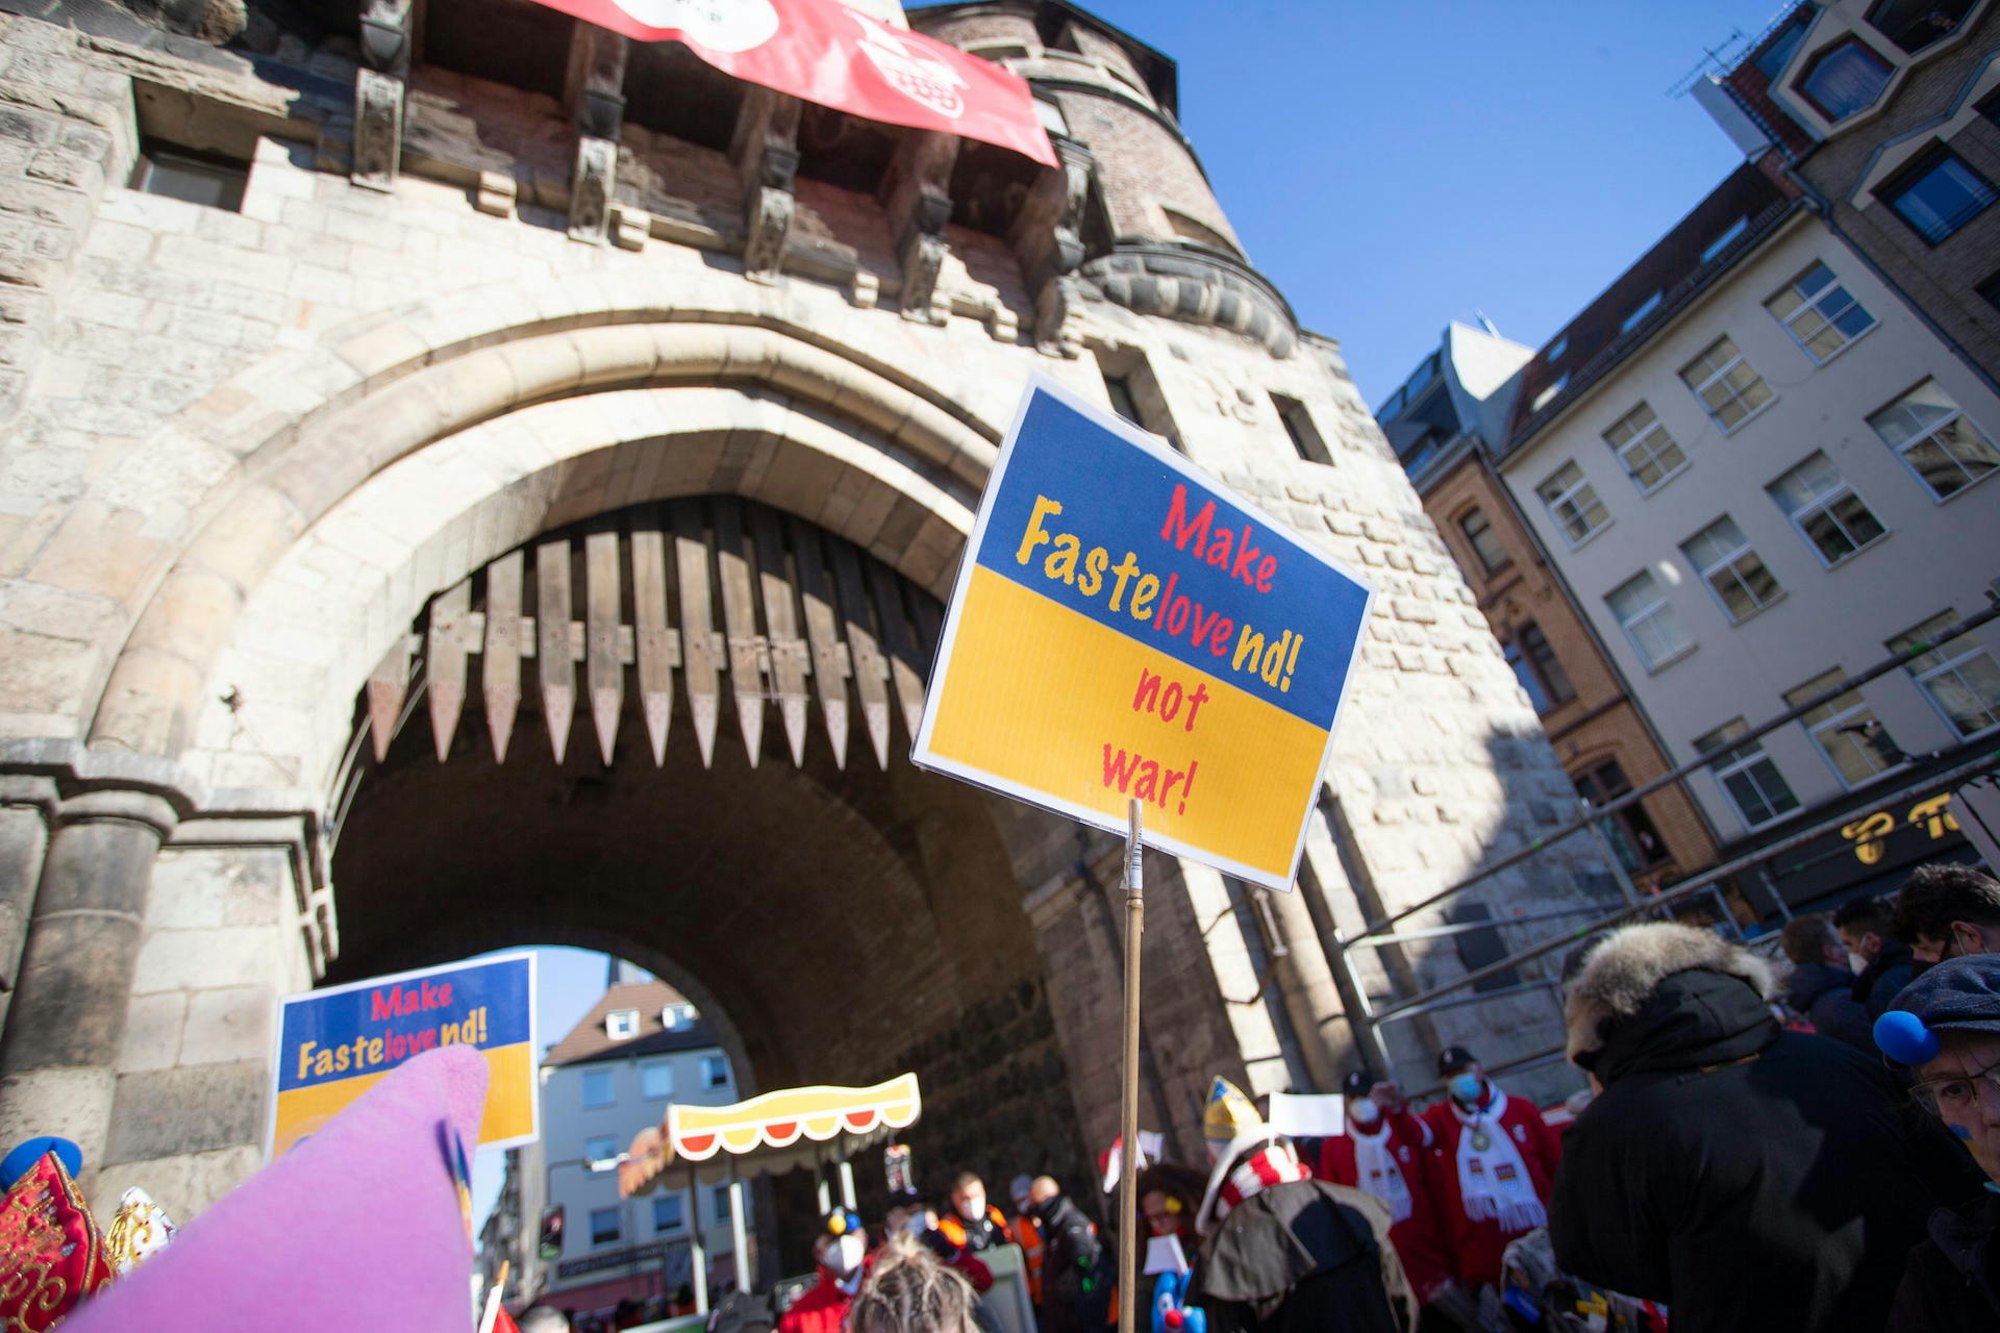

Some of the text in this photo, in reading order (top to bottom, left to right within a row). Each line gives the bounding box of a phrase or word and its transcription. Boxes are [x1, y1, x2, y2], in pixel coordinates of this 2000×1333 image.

[1161, 484, 1277, 593] Make
[1016, 495, 1303, 692] Fastelovend!
[1132, 668, 1208, 732] not
[1102, 743, 1198, 815] war!
[371, 980, 453, 1021] Make
